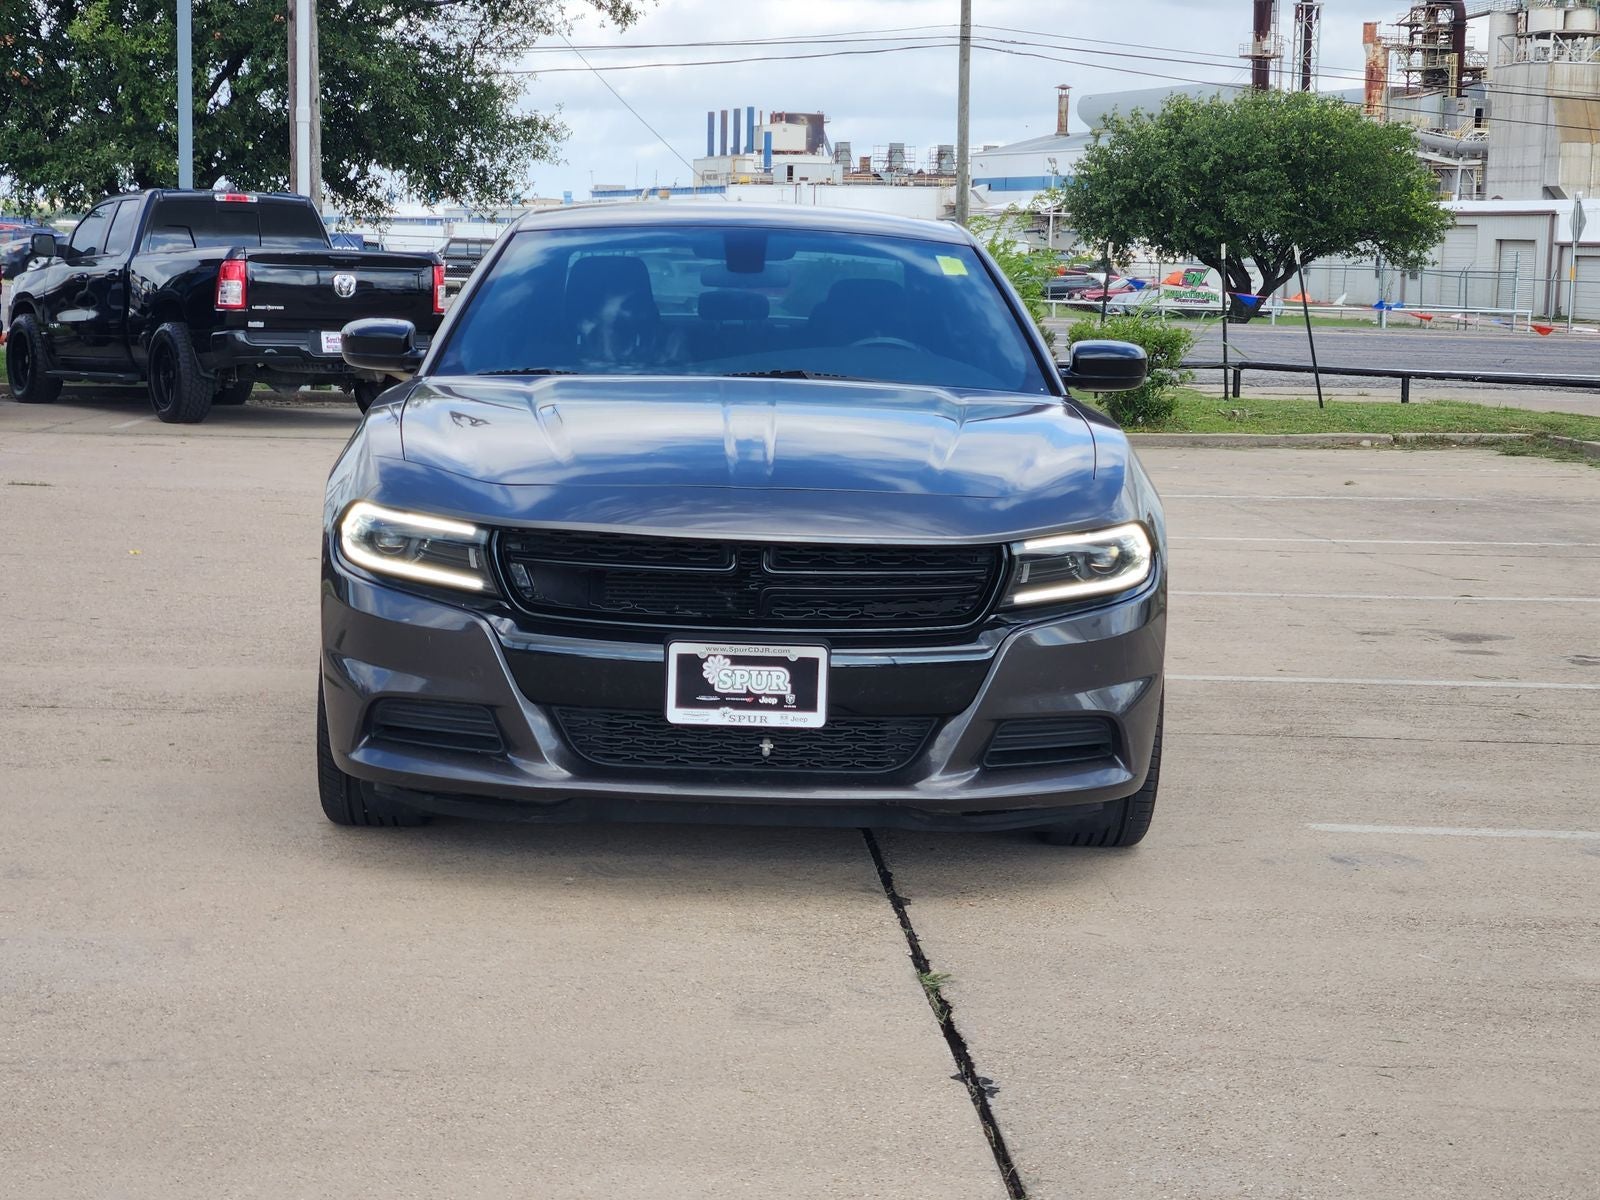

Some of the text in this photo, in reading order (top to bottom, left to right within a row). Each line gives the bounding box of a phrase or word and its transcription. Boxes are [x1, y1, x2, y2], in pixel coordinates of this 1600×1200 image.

[705, 646, 791, 654] www.SpurCDJR.com
[718, 669, 787, 691] SPUR
[758, 696, 778, 705] Jeep
[728, 714, 768, 724] SPUR
